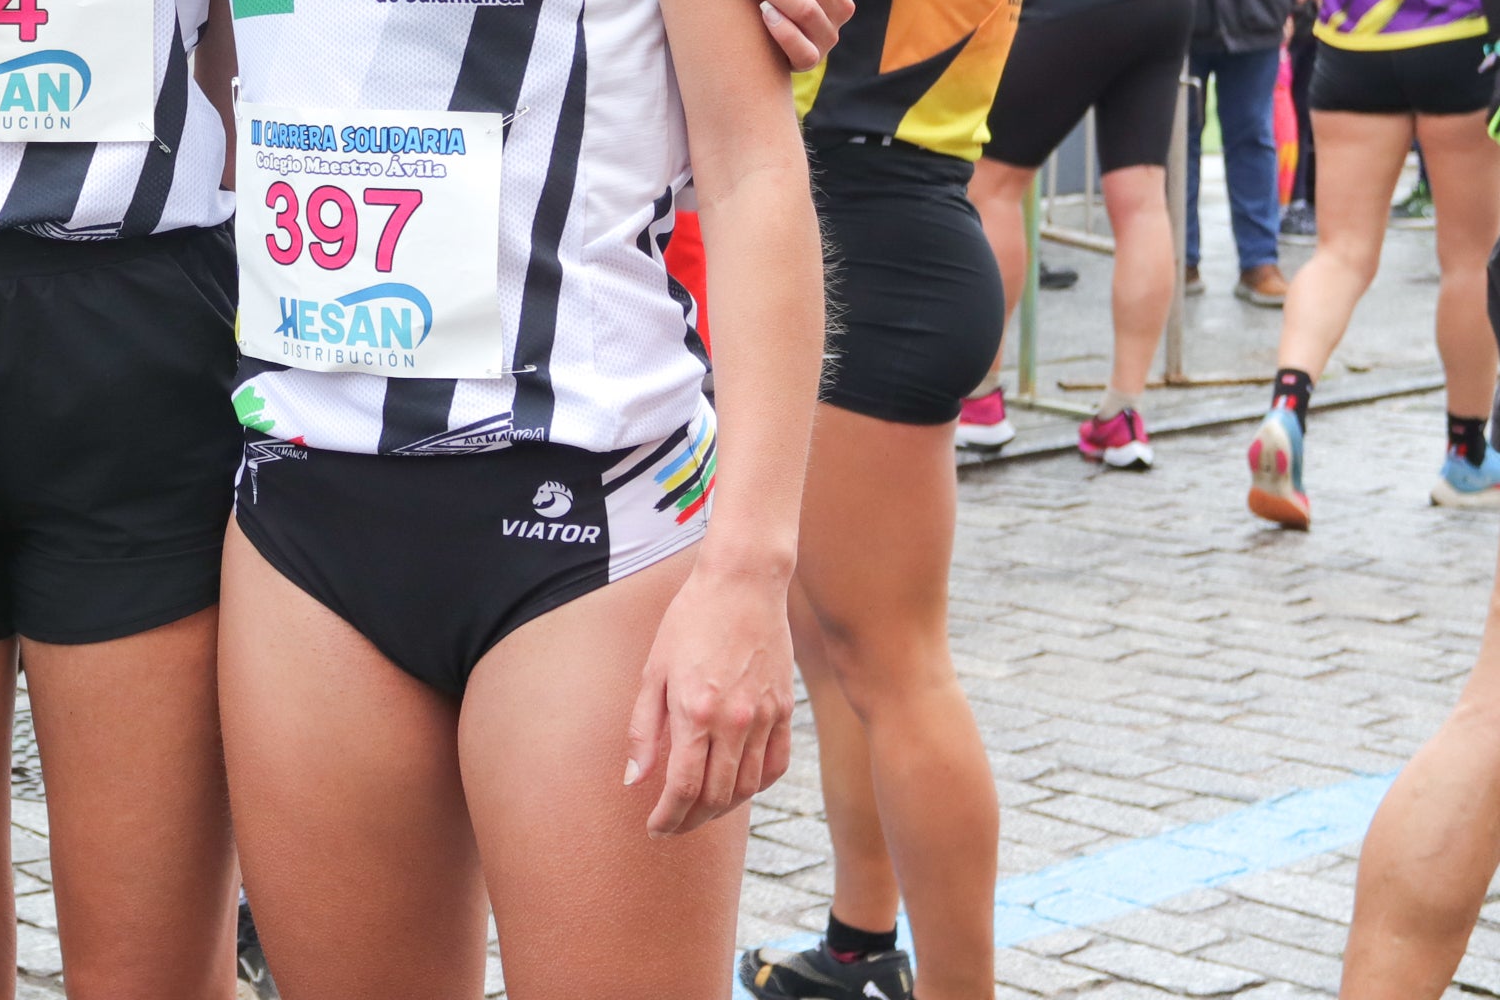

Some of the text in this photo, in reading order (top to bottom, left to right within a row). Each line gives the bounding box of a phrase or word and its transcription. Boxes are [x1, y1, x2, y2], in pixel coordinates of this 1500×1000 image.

[251, 119, 466, 155] III CARRERA SOLIDARIA
[256, 151, 447, 178] Colegio Maestro Ávila
[266, 181, 423, 273] 397
[274, 296, 414, 350] HESAN
[283, 341, 415, 368] DISTRIBUCIÓN
[502, 519, 601, 544] VIATOR
